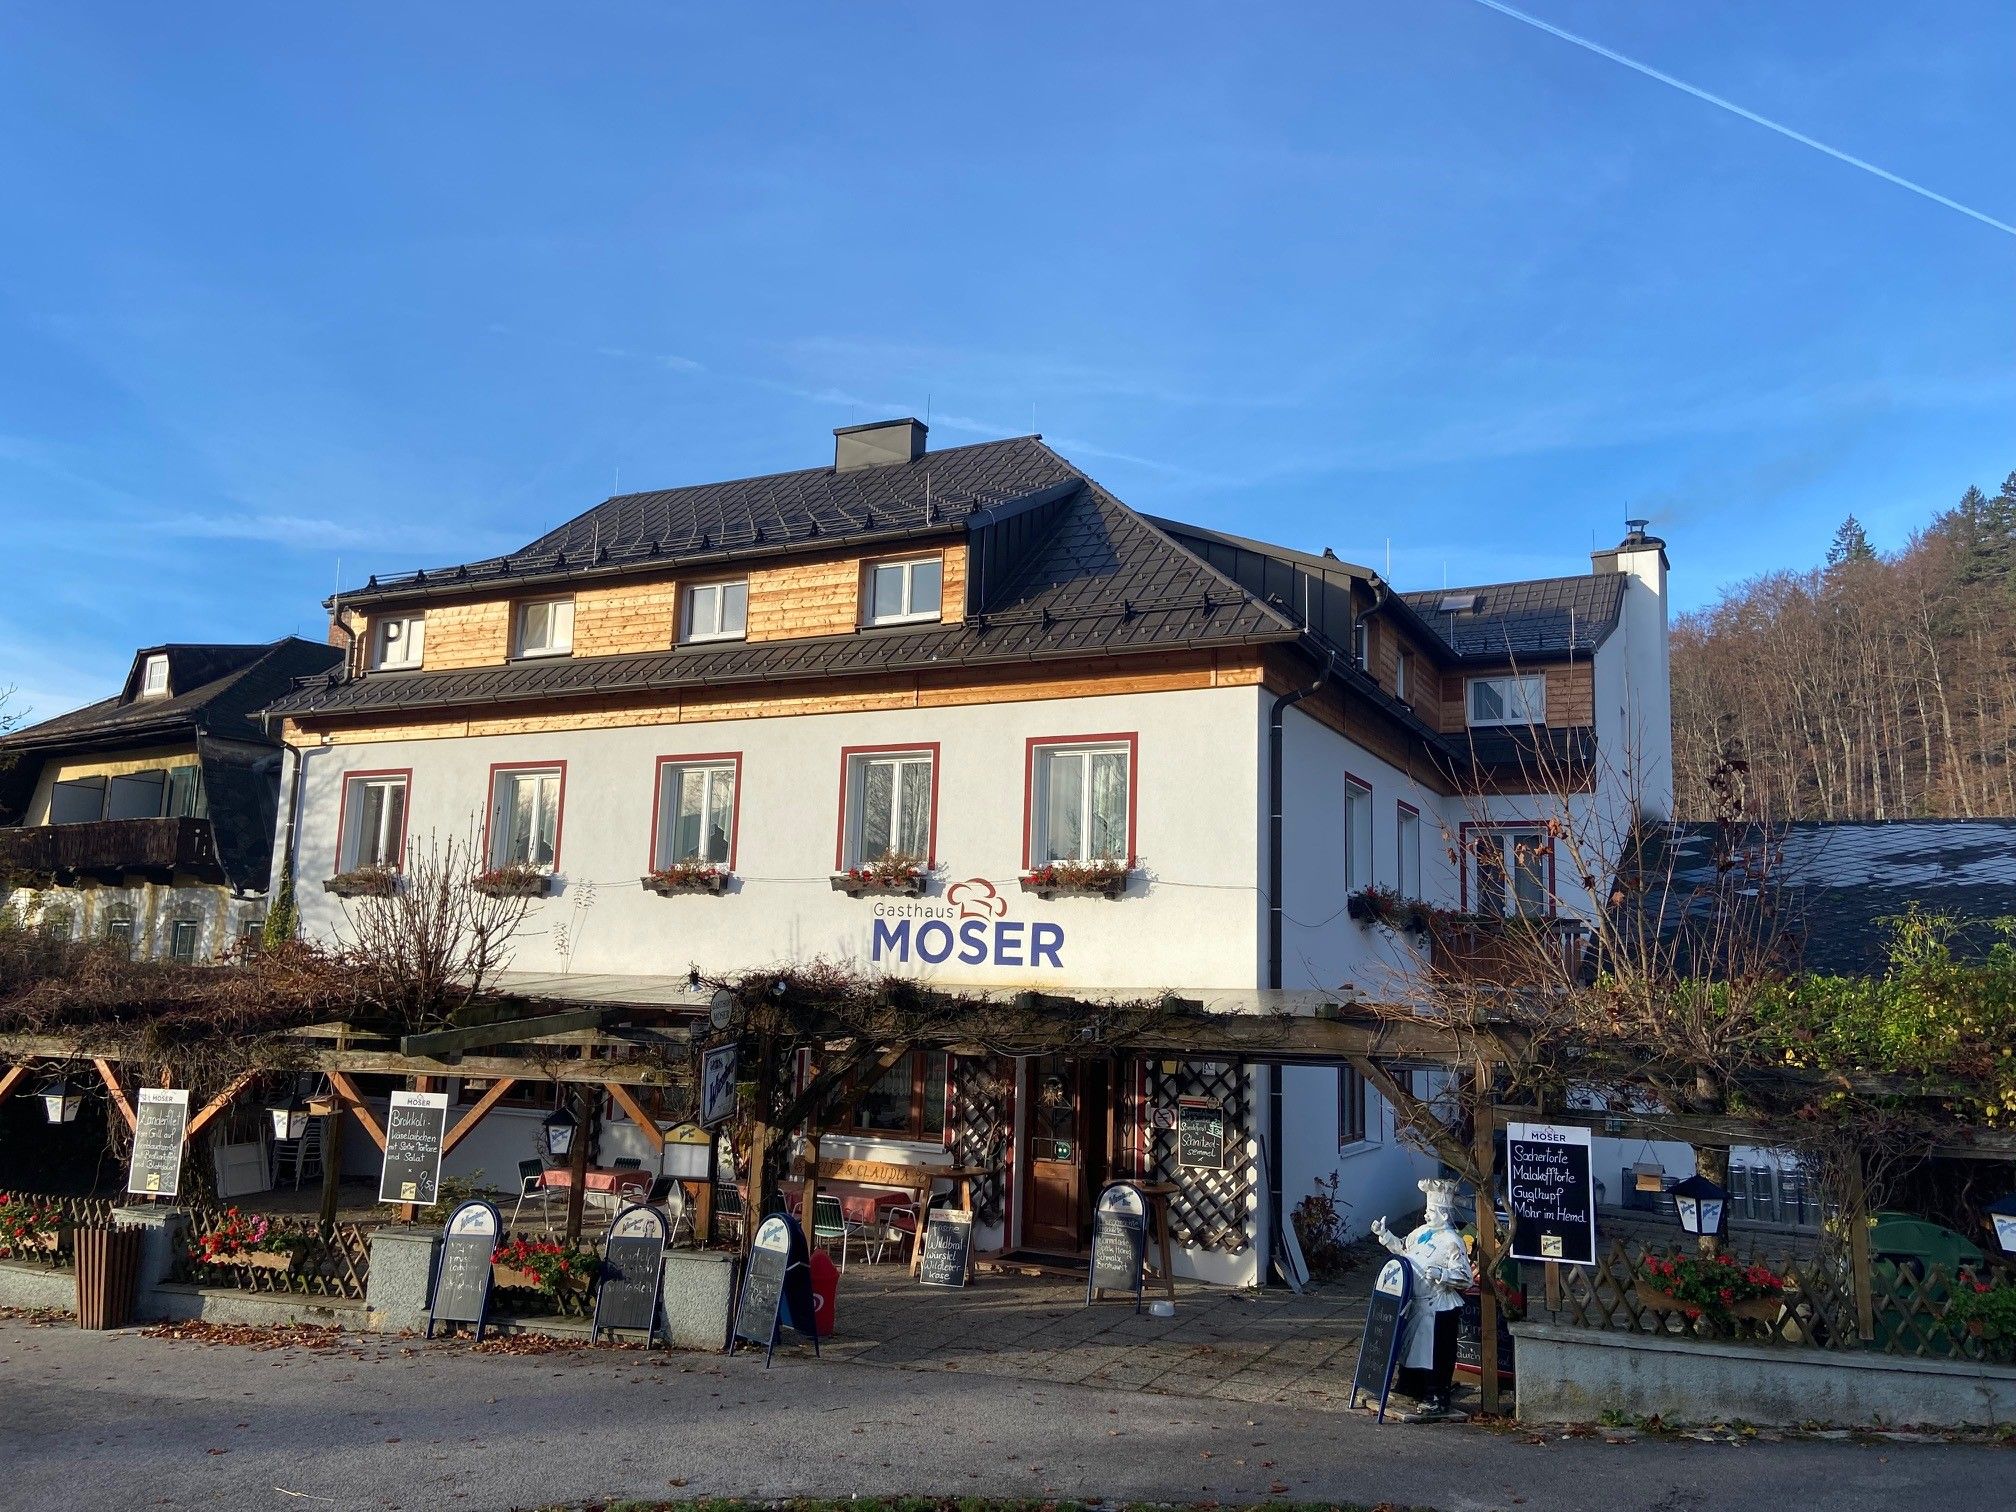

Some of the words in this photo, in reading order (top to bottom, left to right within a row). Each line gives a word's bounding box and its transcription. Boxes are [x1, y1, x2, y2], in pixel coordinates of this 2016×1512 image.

[873, 902, 954, 919] Gasthaus
[872, 918, 1065, 968] MOSER
[407, 1099, 431, 1107] MOSER
[163, 1128, 176, 1142] auf
[1531, 1132, 1566, 1142] MOSER
[403, 1152, 426, 1162] Salat
[1513, 1144, 1569, 1164] Sachertorte
[856, 1164, 909, 1181] CLAUDIA
[1513, 1165, 1576, 1186] Malakofftorte
[1512, 1185, 1564, 1206] Guglhupf
[1514, 1201, 1542, 1219] Mohr
[1543, 1208, 1555, 1220] im
[1556, 1206, 1587, 1223] Hemd
